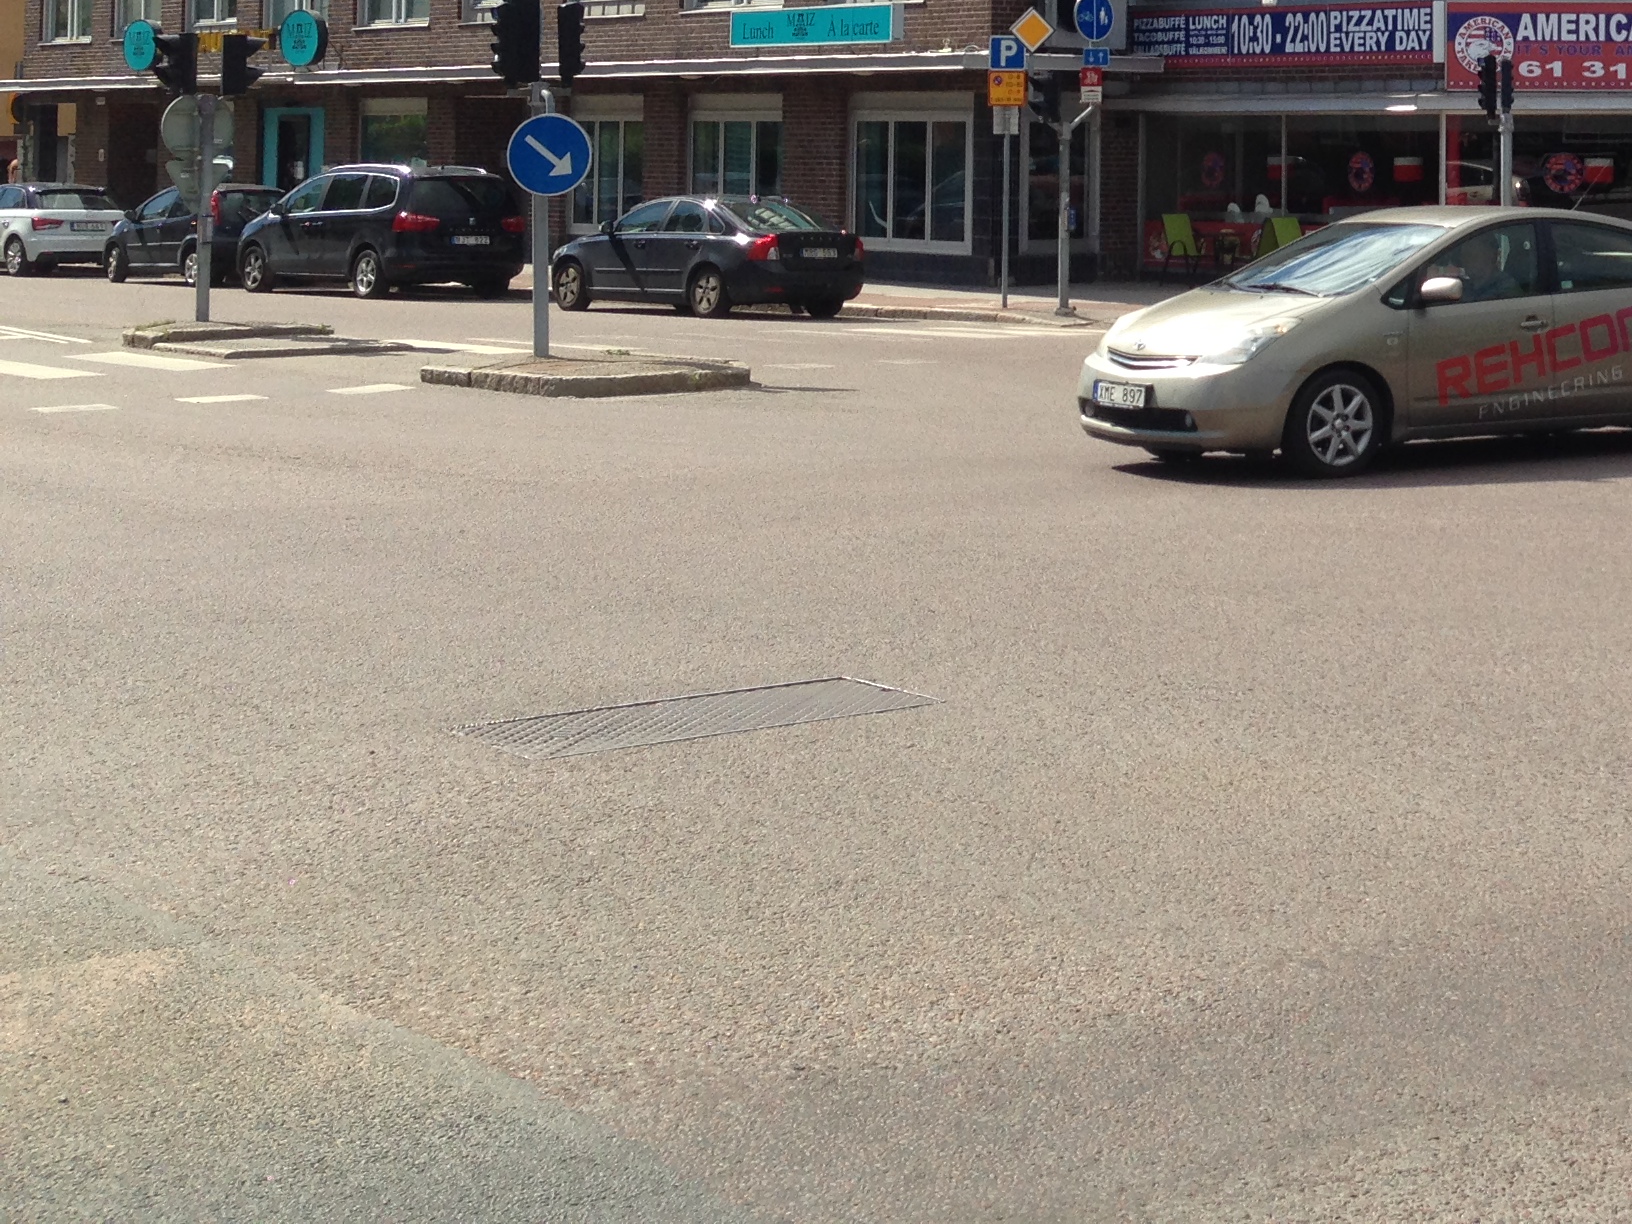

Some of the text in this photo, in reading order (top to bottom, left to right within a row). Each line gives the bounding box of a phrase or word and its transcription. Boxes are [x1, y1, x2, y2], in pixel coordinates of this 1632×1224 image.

[840, 19, 849, 36] la
[852, 21, 879, 37] carte
[1189, 15, 1227, 29] LUNCH
[1330, 7, 1431, 32] PIZZATIME
[1458, 17, 1512, 40] AMERICAN
[742, 22, 774, 40] Lunch
[1231, 13, 1272, 55] 10:30
[1285, 11, 1327, 53] 22:00
[1330, 30, 1431, 52] EVERY DAY
[1556, 44, 1601, 56] YOUR
[1001, 40, 1017, 67] P
[1518, 60, 1562, 77] 61
[1582, 60, 1627, 79] 31
[1122, 388, 1142, 404] 897
